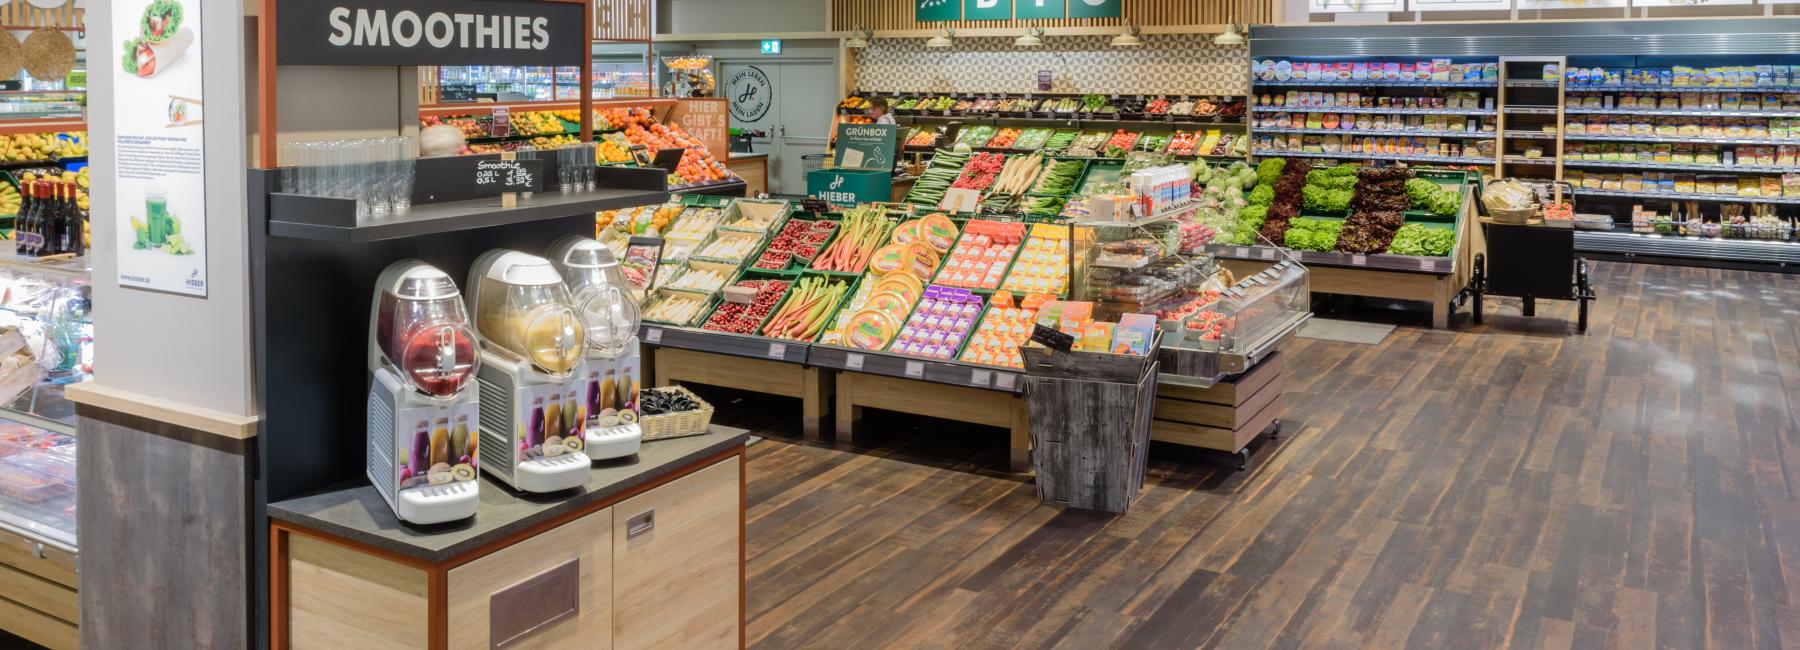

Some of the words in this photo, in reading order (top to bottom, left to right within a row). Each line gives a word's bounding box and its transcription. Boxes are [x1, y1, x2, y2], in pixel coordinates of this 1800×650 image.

[328, 6, 550, 51] SMOOTHIES
[732, 71, 747, 87] MEIN
[747, 71, 766, 87] LEBEN
[689, 101, 718, 113] HIER
[732, 101, 746, 117] MEIN
[746, 101, 764, 118] LADEN
[845, 126, 888, 137] GRÜNBOX
[477, 160, 520, 170] Smoothie
[818, 191, 856, 202] HIEBER
[185, 279, 204, 287] HIEBER
